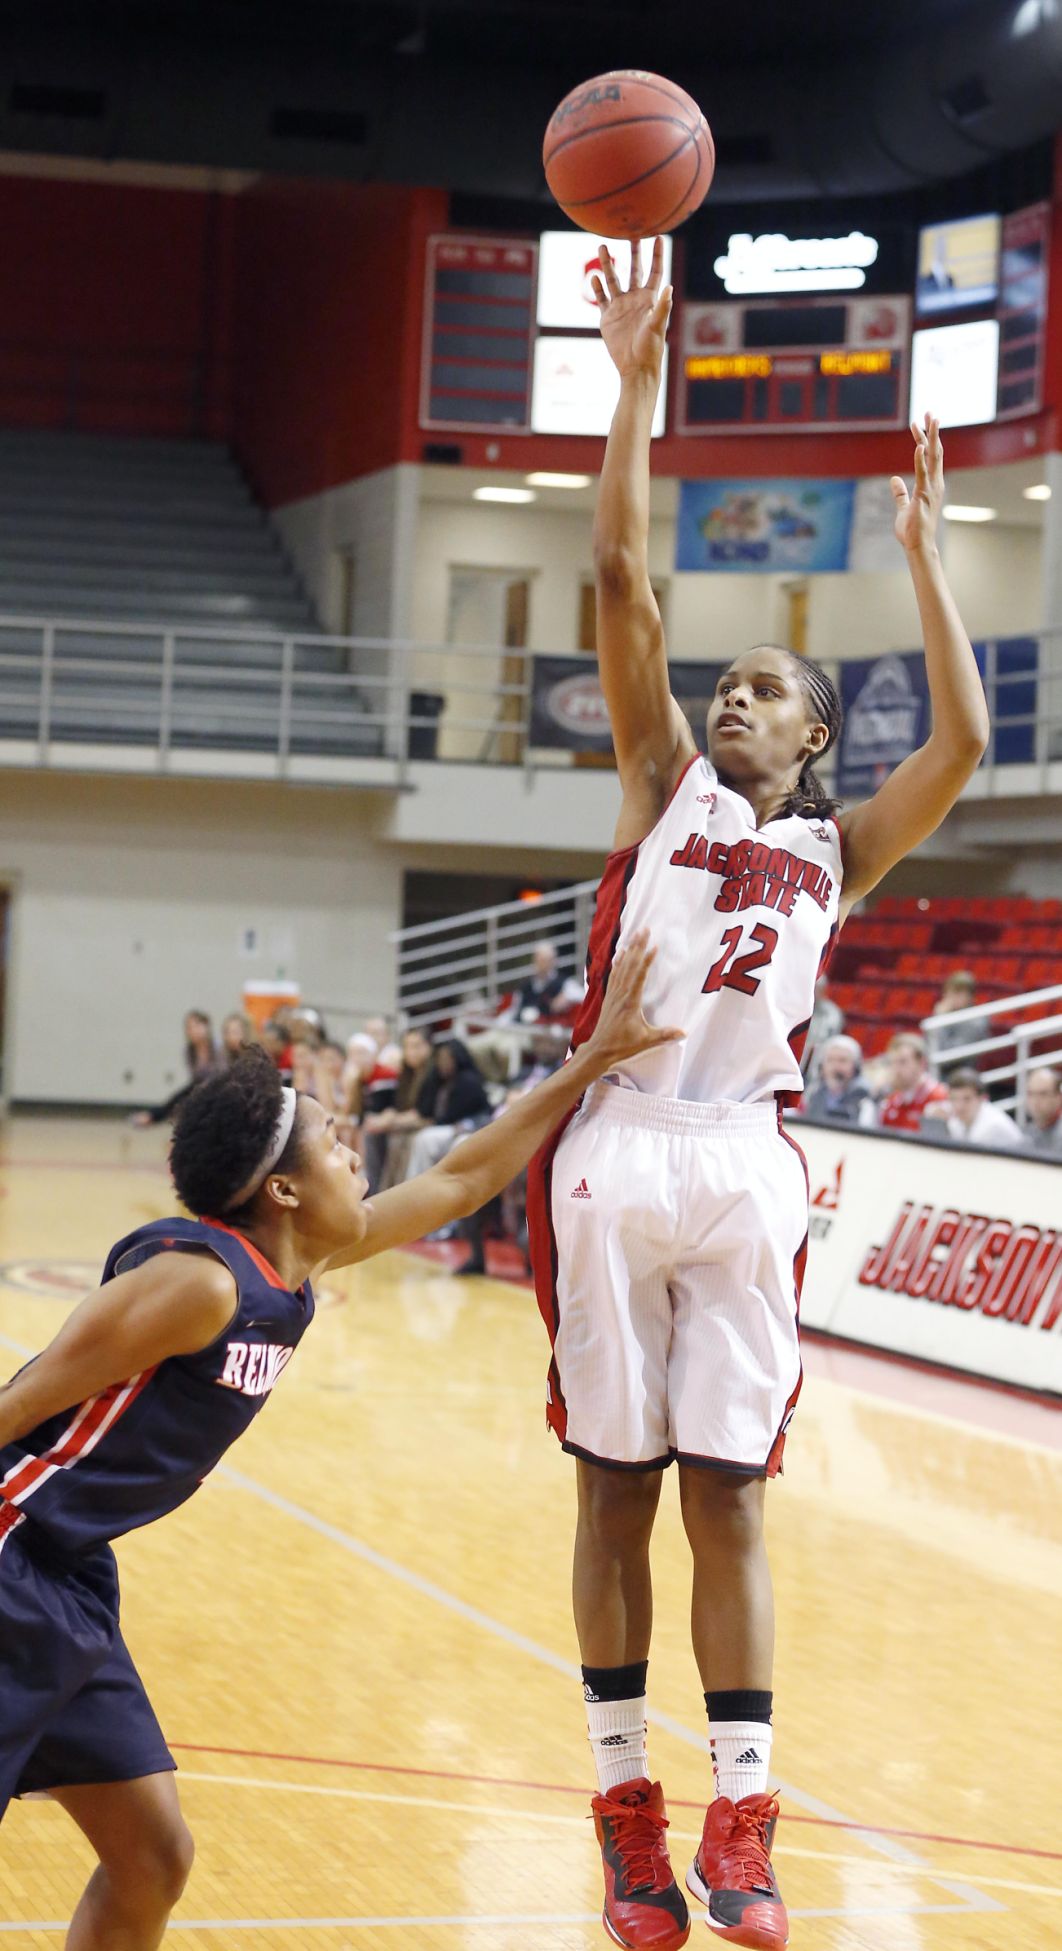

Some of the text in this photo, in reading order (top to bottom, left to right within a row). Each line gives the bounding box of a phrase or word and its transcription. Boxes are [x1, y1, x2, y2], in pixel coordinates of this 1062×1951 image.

[669, 833, 833, 912] JACKSONVILLE
[713, 873, 801, 918] STATE
[571, 1191, 592, 1200] adidas
